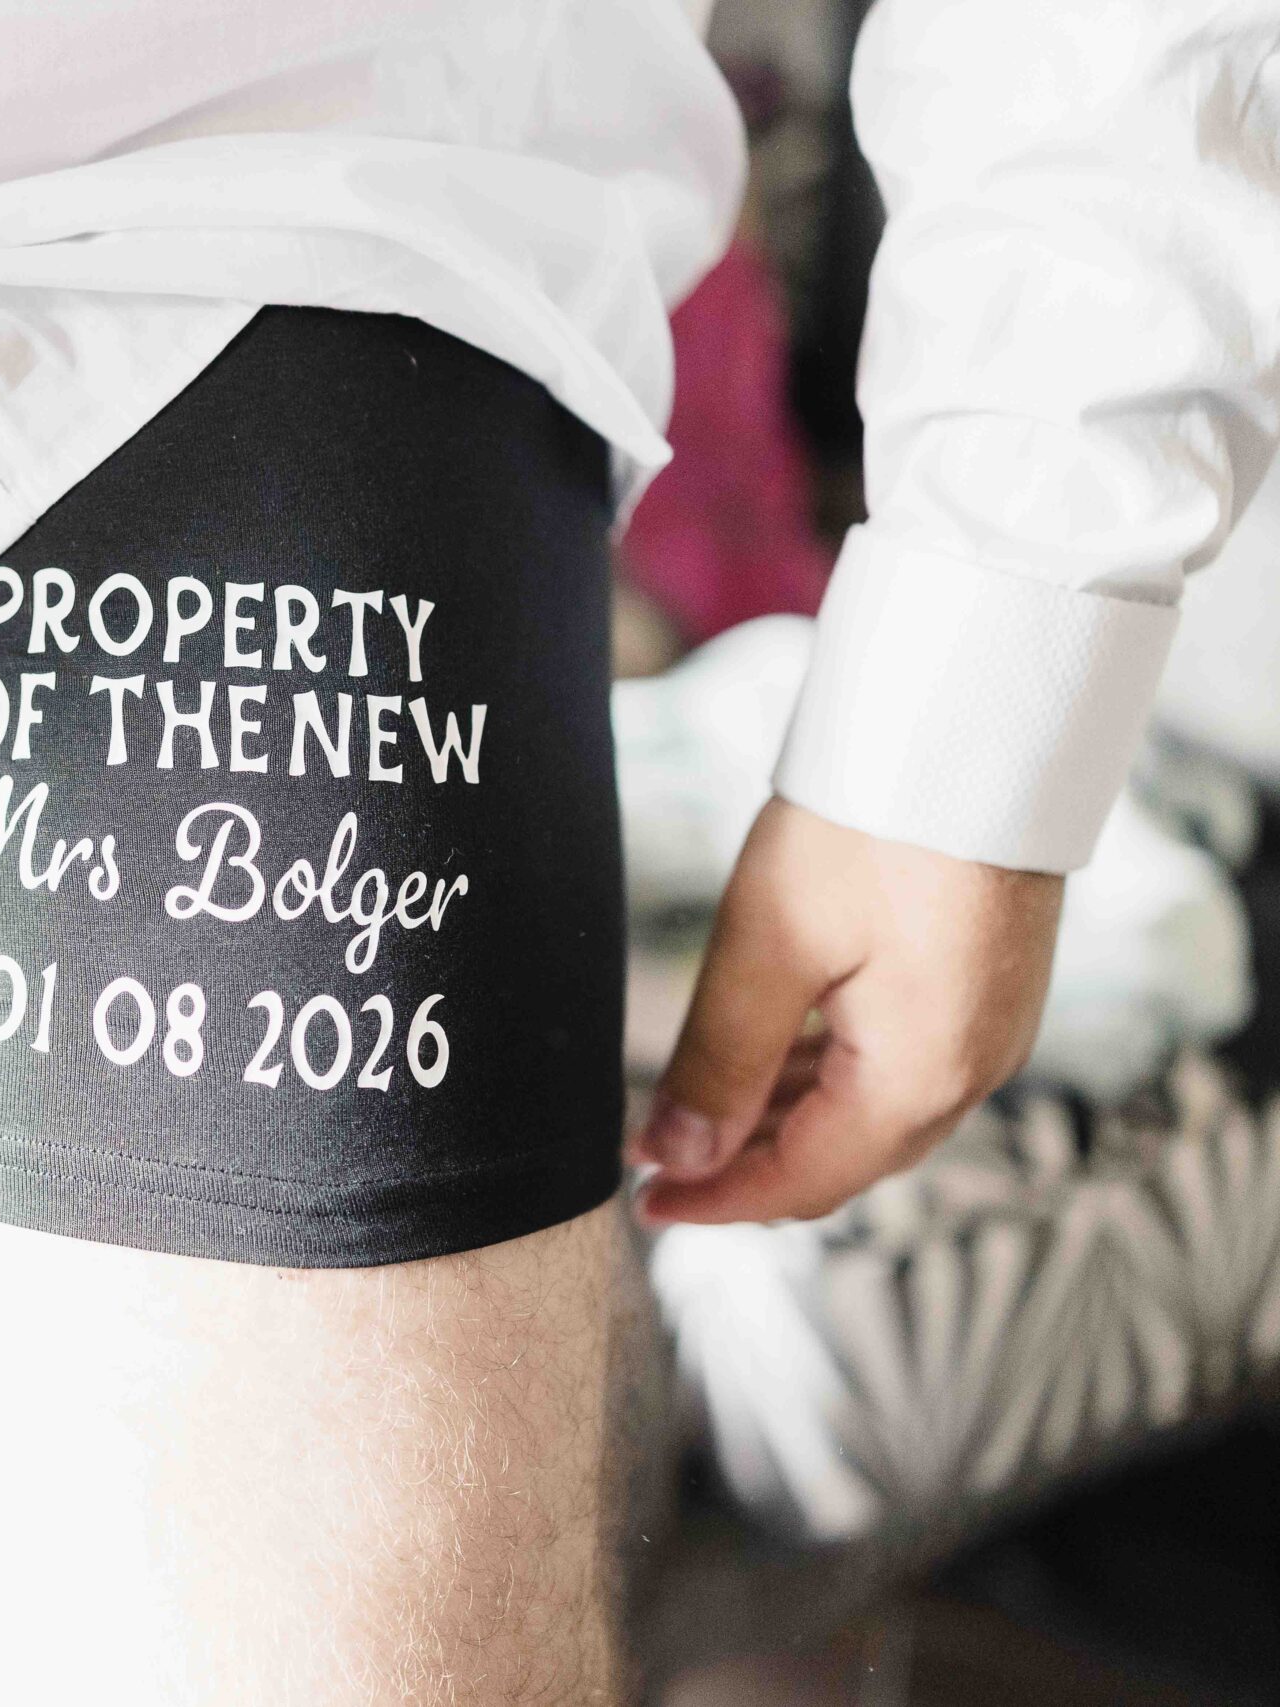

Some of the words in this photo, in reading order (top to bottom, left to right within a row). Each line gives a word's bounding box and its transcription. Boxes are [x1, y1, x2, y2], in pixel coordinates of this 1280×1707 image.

[88, 672, 269, 775] THE
[288, 689, 489, 785] NEW
[164, 800, 470, 975] Bolger
[93, 976, 207, 1079] 08
[241, 989, 450, 1093] 2026
